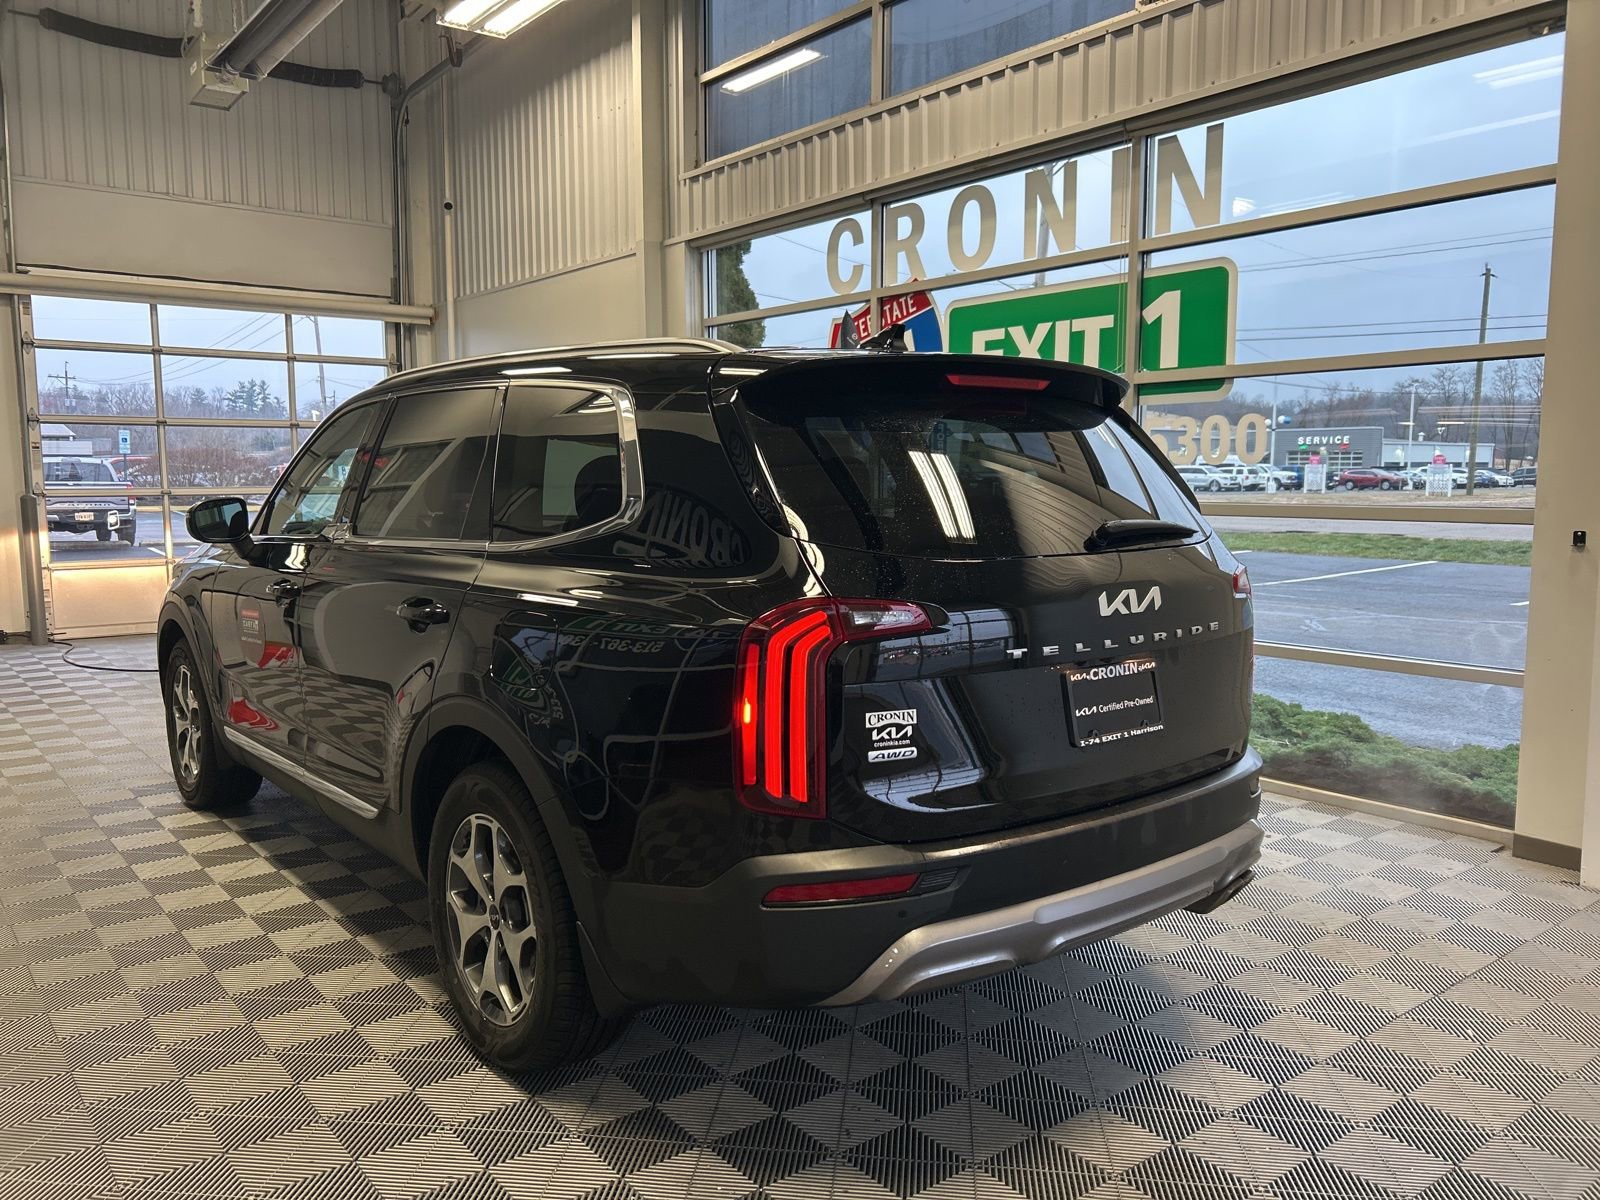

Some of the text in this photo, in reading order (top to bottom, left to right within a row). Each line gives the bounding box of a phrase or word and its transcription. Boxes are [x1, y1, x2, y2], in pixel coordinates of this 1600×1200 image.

[826, 122, 1224, 296] CRONIN
[1141, 289, 1181, 369] 1
[1297, 435, 1350, 445] SERVICE
[1098, 586, 1162, 617] KIA
[1006, 621, 1219, 660] TELLURIDE
[1070, 661, 1156, 681] KIA CRONIN KIA
[1075, 696, 1154, 717] KIA Certified Pre-Owned
[868, 710, 915, 726] CRONIN
[872, 725, 913, 740] KIA
[1080, 737, 1101, 747] I-74
[1102, 732, 1122, 742] EXIT
[1130, 724, 1164, 736] Harrison
[873, 739, 911, 748] croninkia.com
[871, 750, 915, 761] AWD
